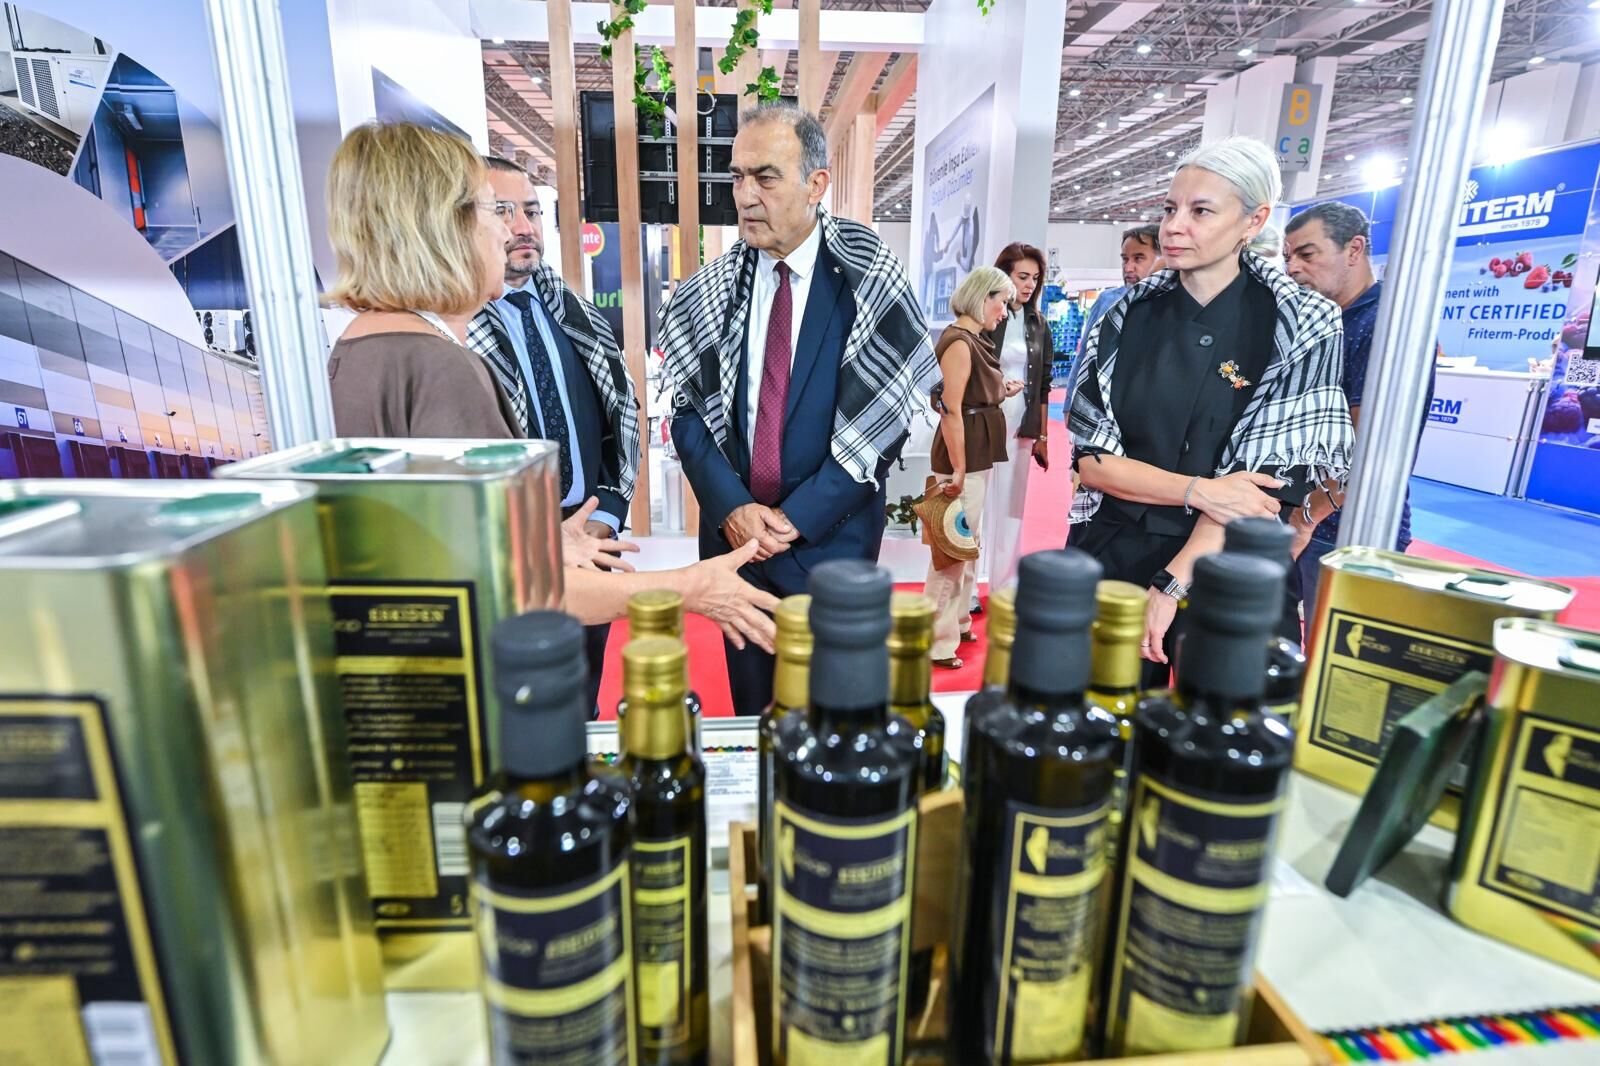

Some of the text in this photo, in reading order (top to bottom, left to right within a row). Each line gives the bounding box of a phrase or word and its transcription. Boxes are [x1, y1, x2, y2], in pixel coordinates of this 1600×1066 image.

[1288, 88, 1312, 125] B
[1297, 137, 1310, 154] a
[1473, 285, 1500, 298] with
[1469, 304, 1567, 320] CERTIFIED
